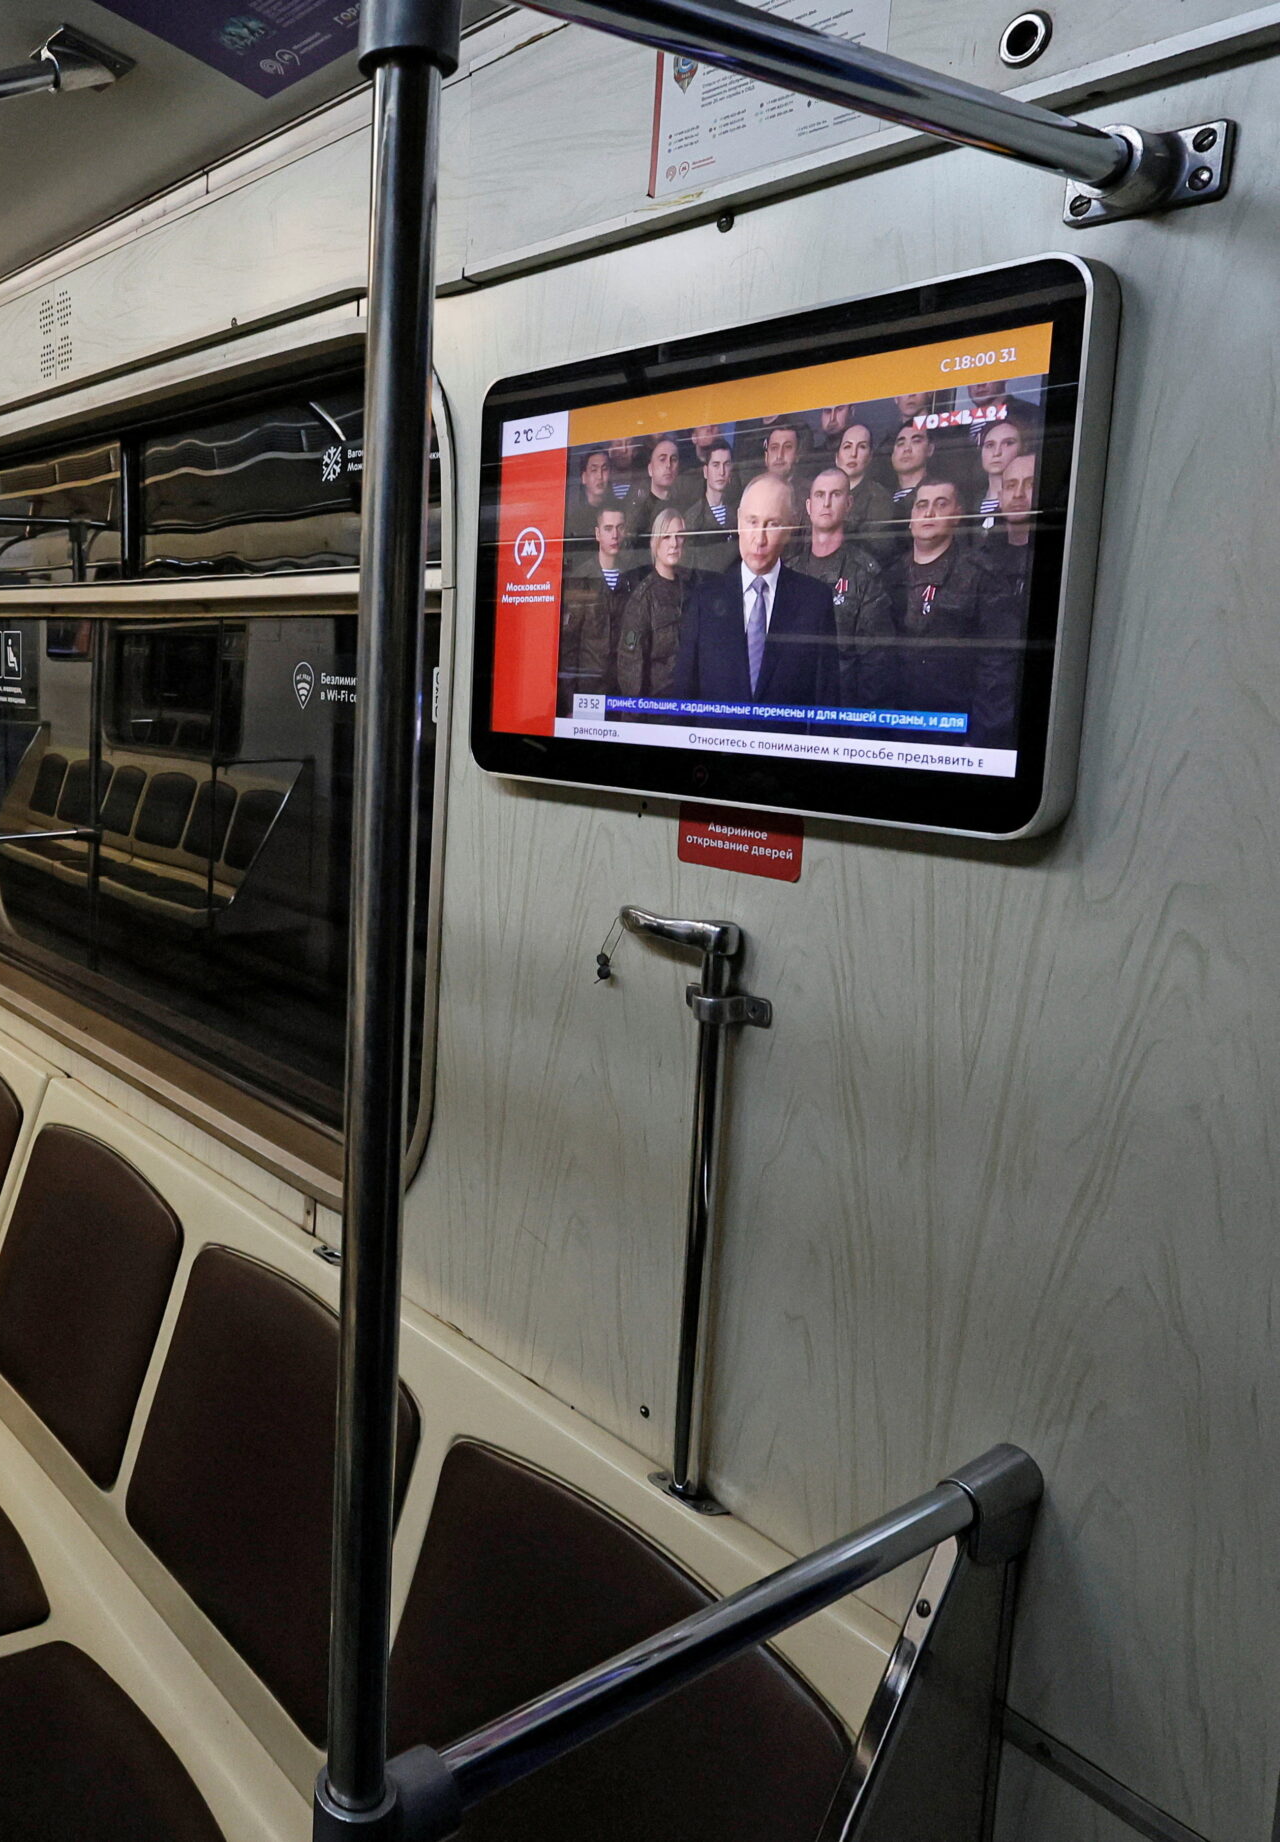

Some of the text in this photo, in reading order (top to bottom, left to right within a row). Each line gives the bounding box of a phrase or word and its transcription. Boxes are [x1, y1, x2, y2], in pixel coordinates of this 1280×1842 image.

[940, 347, 1017, 372] С 18:00 31
[513, 430, 521, 444] 2
[347, 462, 364, 472] Мож
[506, 581, 551, 592] Московский
[501, 594, 555, 606] Метрополитен
[320, 691, 326, 701] в
[326, 689, 348, 702] Wi-Fi
[606, 698, 965, 728] принёс большие, кардинальные перемены и для нашей страны, и для
[573, 725, 620, 738] ранспорта.
[688, 732, 747, 749] Относитесь
[750, 740, 756, 749] с
[758, 741, 830, 755] пониманием
[833, 747, 840, 756] к
[843, 747, 893, 760] просьбе
[897, 751, 974, 768] предъявить
[708, 822, 768, 840] Аварийное
[686, 834, 793, 860] открывание дверей
